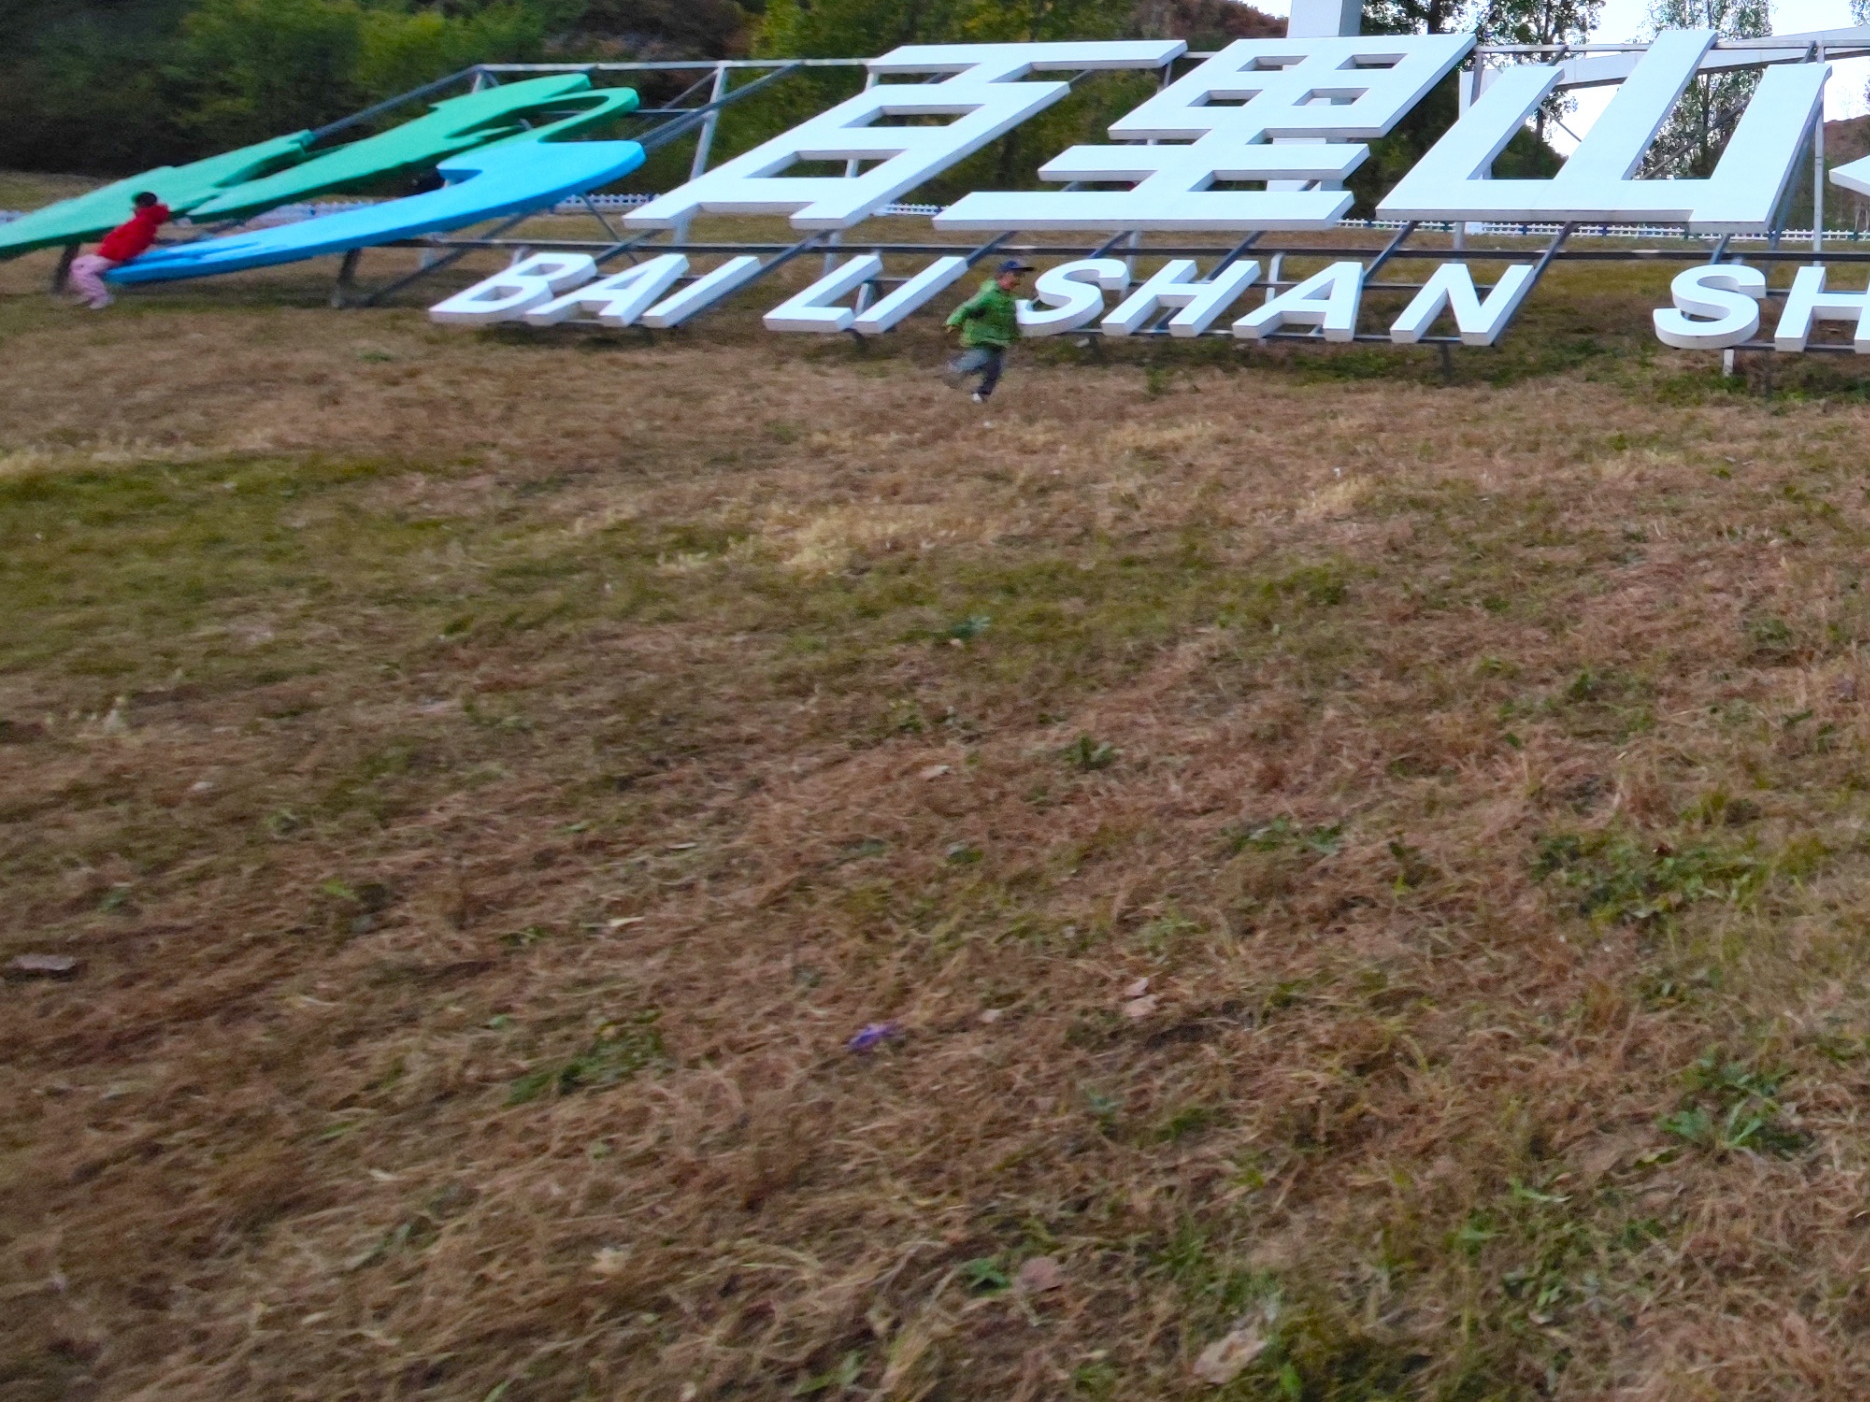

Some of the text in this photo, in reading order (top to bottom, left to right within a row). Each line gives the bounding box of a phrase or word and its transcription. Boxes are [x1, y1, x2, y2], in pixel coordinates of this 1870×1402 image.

[429, 252, 760, 329] BAI
[762, 254, 969, 334] LI
[1016, 257, 1535, 347] SHAN
